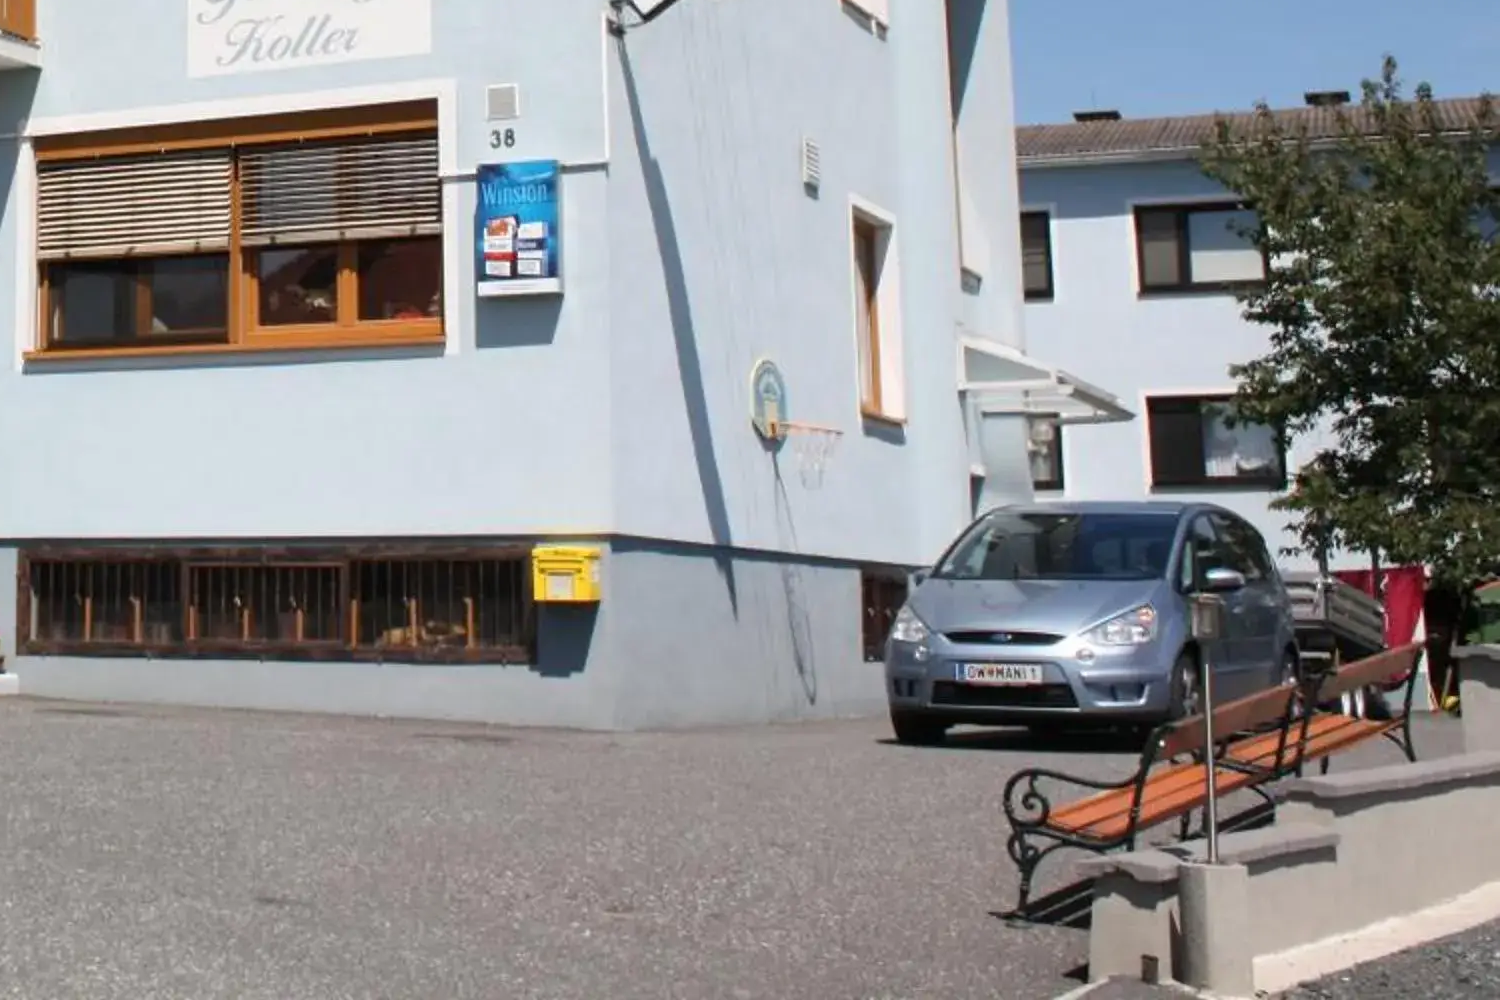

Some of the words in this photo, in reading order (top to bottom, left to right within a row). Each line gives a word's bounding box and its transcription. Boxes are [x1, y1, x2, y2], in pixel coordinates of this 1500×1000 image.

[216, 13, 360, 67] Koller
[489, 128, 516, 149] 38
[481, 181, 548, 206] Winston
